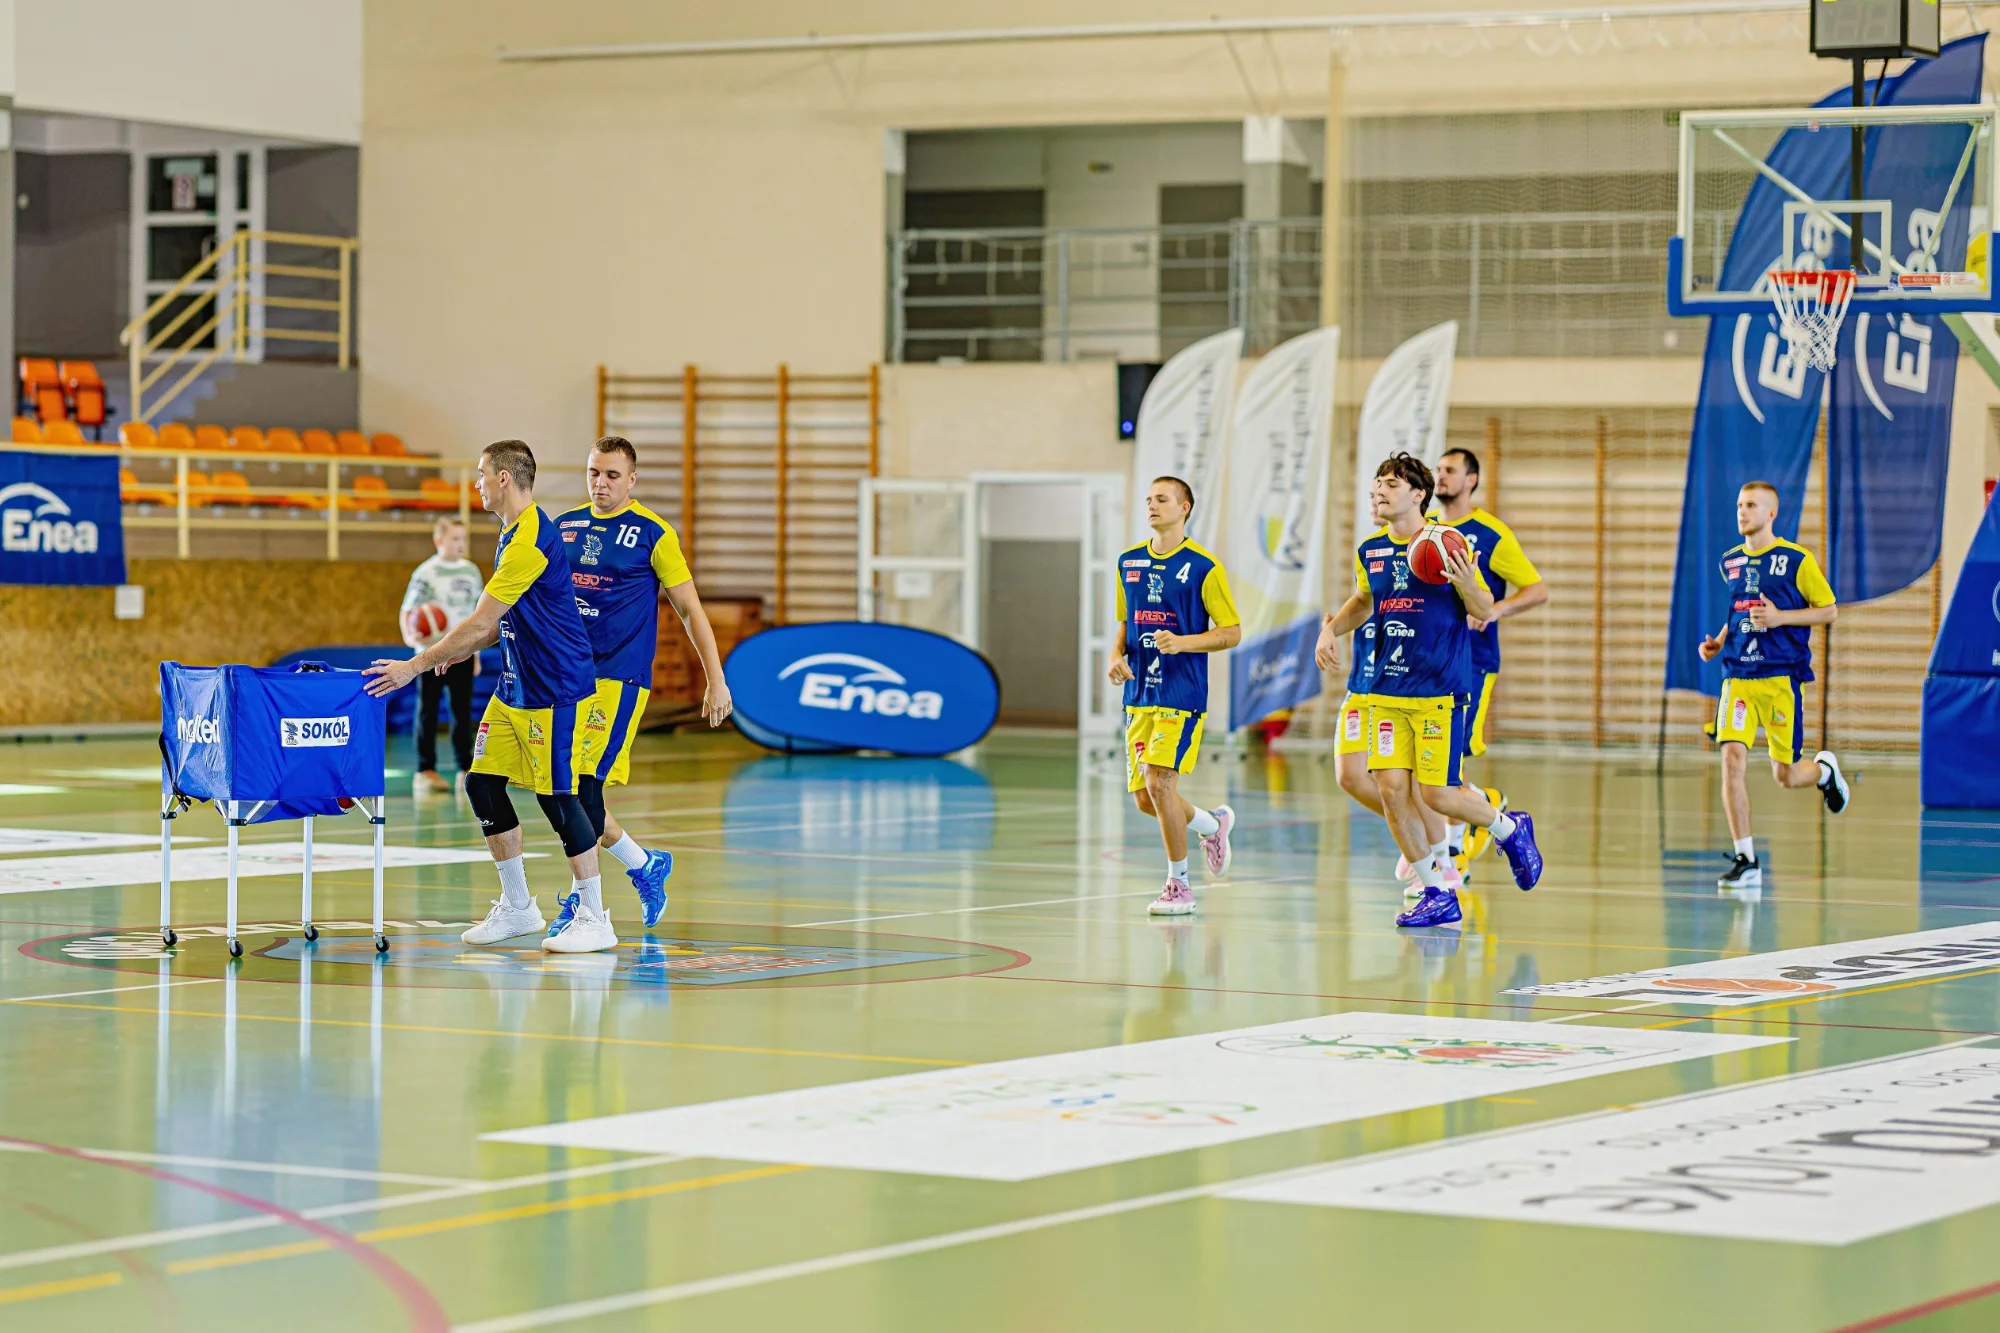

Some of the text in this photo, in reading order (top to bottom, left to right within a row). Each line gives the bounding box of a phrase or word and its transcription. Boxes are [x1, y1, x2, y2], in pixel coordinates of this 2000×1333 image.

[3, 508, 98, 553] Enea
[615, 524, 641, 548] 16
[1175, 562, 1191, 583] 4
[1769, 554, 1789, 576] 13
[578, 606, 599, 617] nea
[1386, 626, 1415, 637] Enea
[1143, 638, 1157, 648] En
[799, 672, 944, 720] Enea
[301, 718, 349, 739] SOKÓŁ
